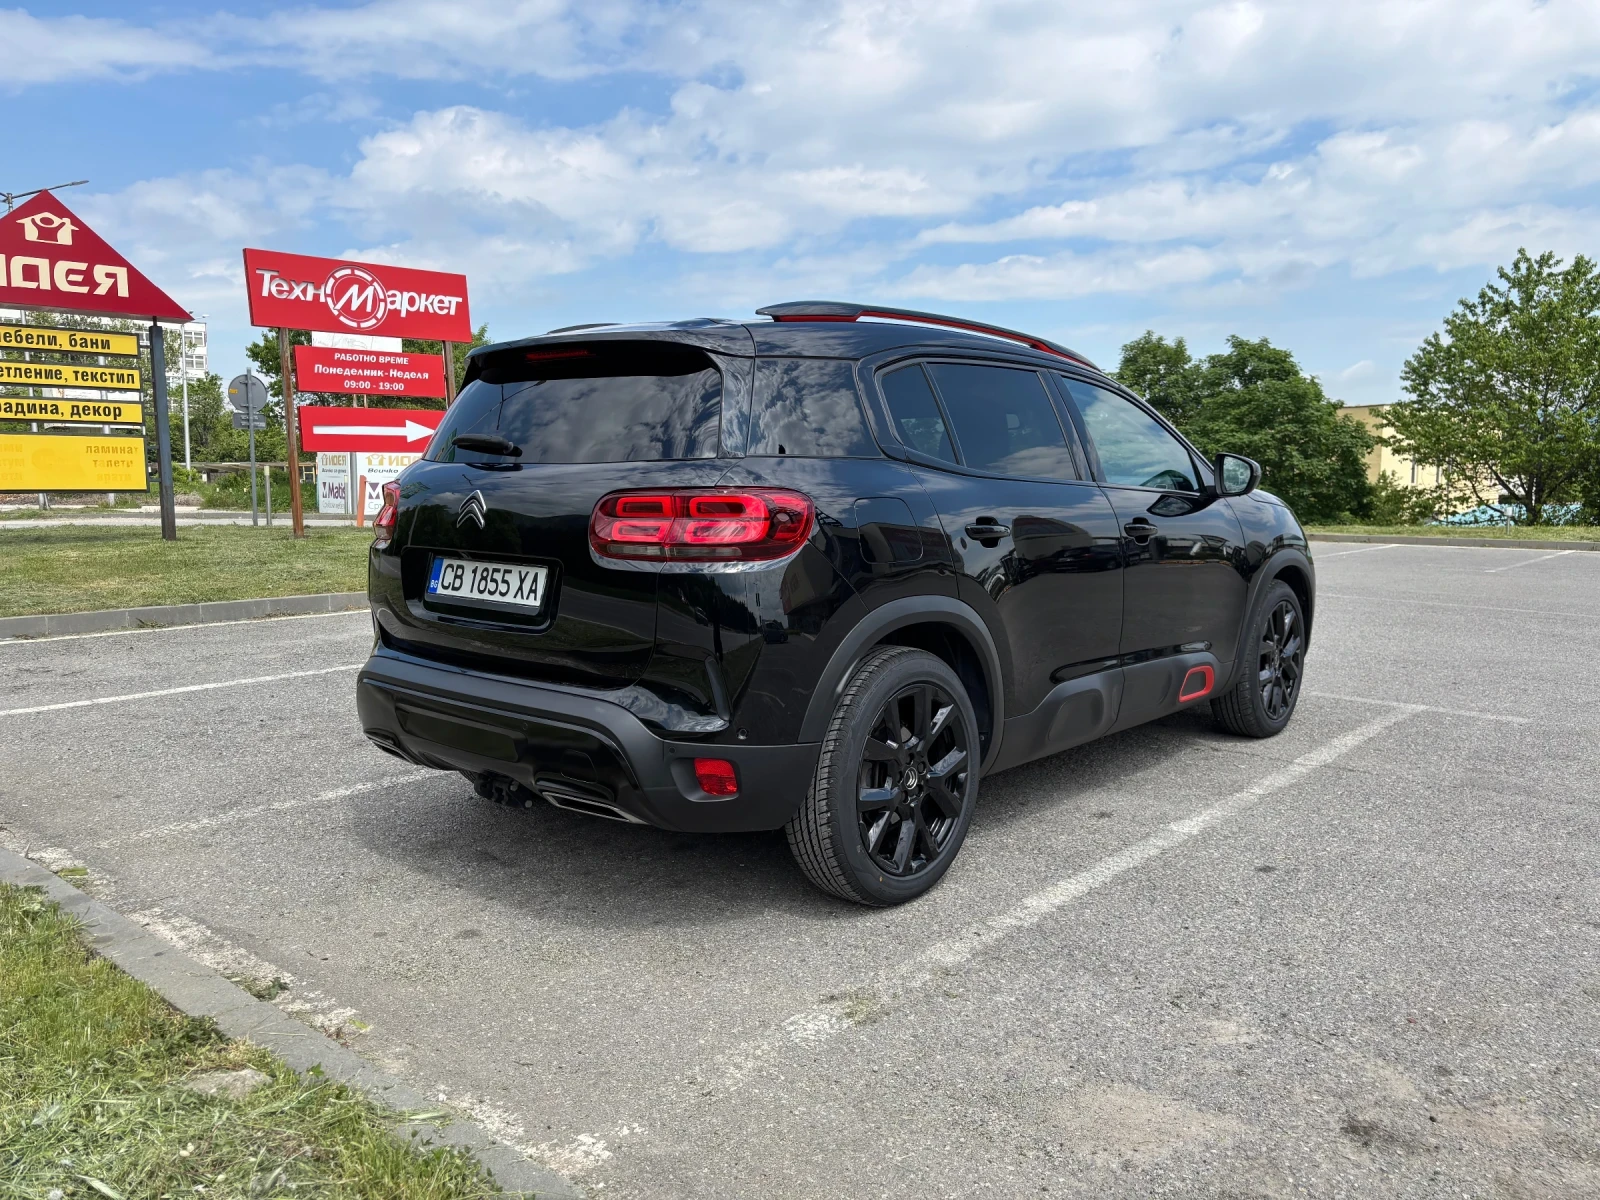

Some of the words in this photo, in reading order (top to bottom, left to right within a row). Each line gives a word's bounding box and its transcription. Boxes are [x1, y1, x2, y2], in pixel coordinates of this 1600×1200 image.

[0, 254, 129, 298] ДЕЯ
[0, 329, 63, 349] ебели,
[69, 333, 111, 350] бани
[334, 352, 377, 363] РАБОТНО
[378, 355, 409, 365] ВРЕМЕ
[73, 370, 135, 385] текстил
[344, 380, 371, 389] 09:00
[379, 382, 404, 391] 19:00
[0, 401, 65, 417] адина,
[70, 405, 122, 420] декор
[85, 445, 138, 455] ламинат
[430, 579, 439, 588] BG
[440, 563, 465, 591] CB
[469, 565, 513, 597] 1855
[513, 570, 539, 601] XA
